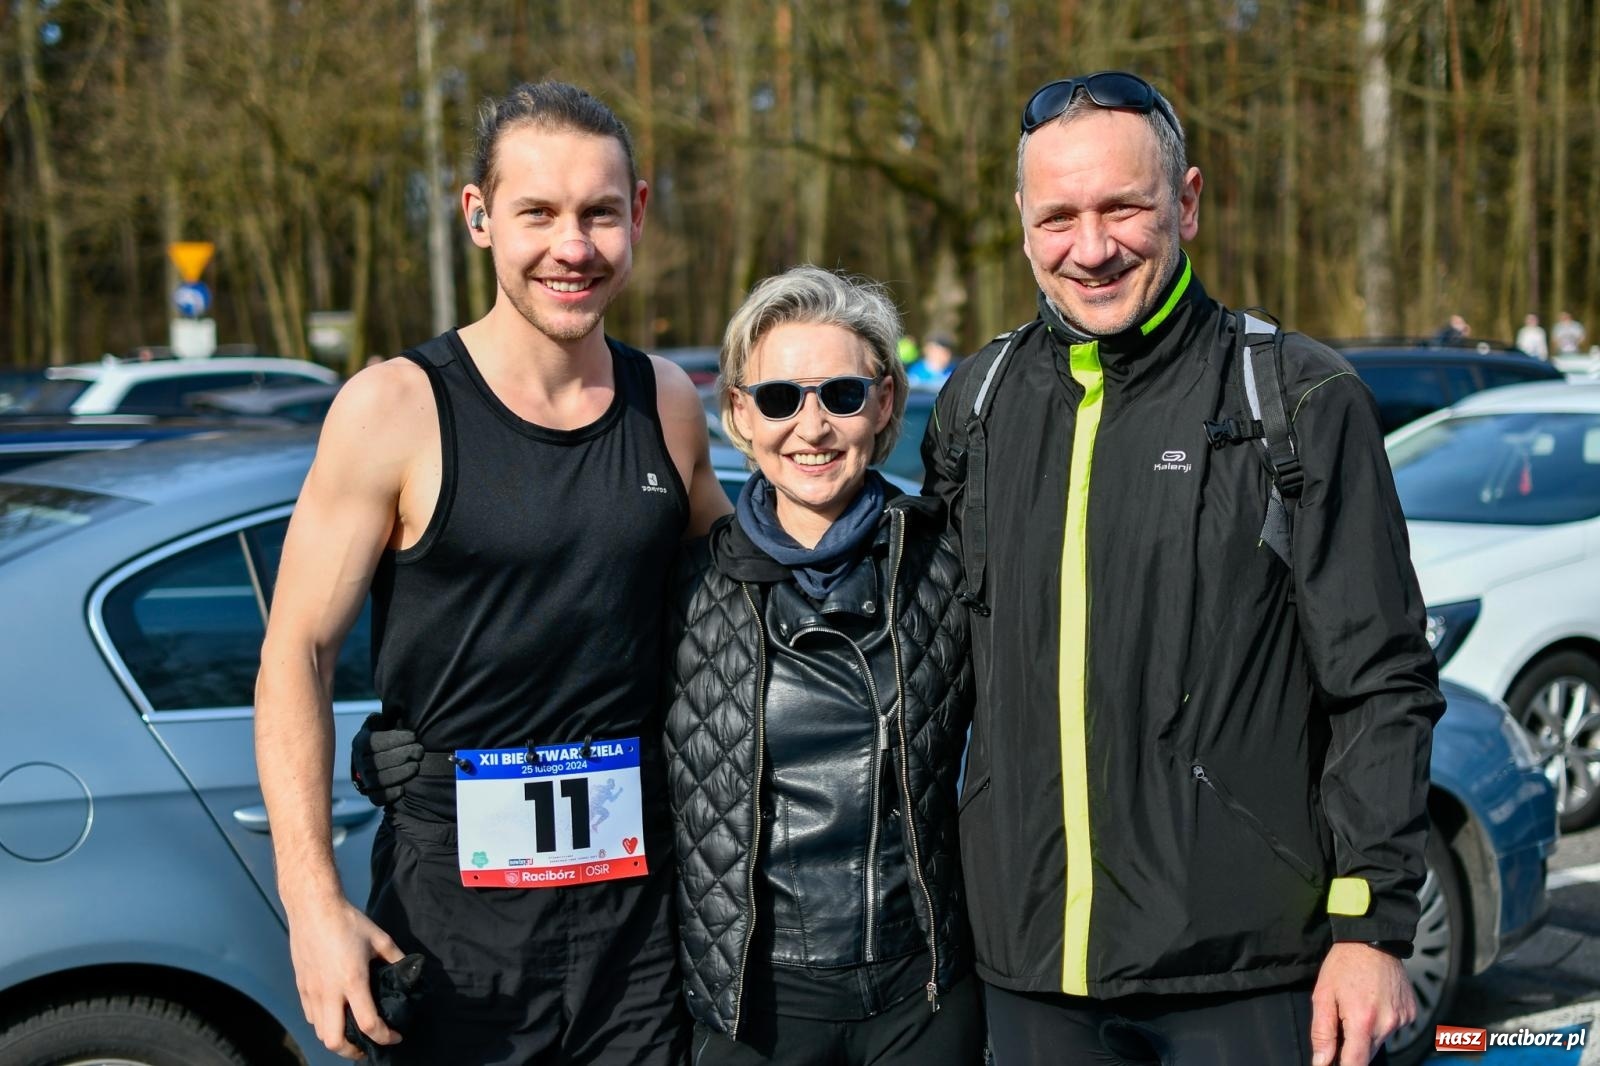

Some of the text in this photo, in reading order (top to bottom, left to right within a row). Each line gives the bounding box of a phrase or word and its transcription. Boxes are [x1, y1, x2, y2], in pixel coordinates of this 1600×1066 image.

[1153, 462, 1192, 473] Kalenji
[479, 743, 624, 766] XII BIE TWARZIELA
[521, 760, 588, 775] 25 lutego 2024
[524, 777, 591, 853] 11
[521, 863, 610, 882] Racibórz OSiR
